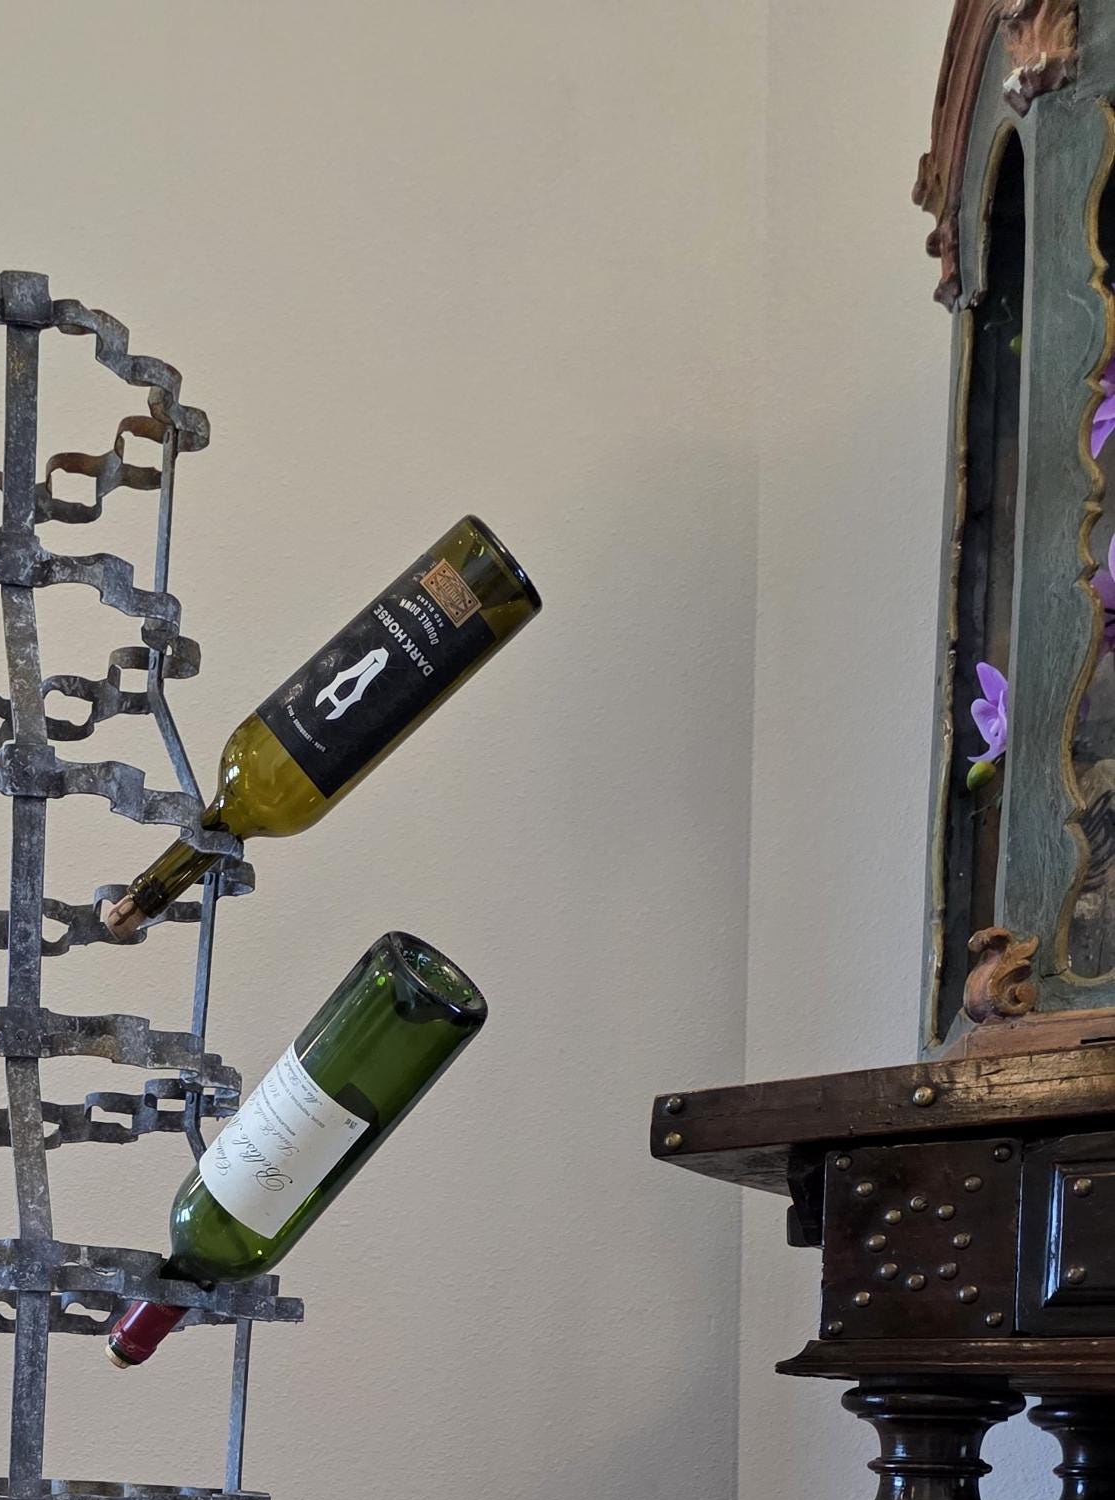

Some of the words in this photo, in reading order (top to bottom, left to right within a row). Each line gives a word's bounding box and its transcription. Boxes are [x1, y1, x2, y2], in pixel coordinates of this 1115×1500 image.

[399, 598, 424, 616] DOWN
[416, 594, 436, 613] BLEND
[373, 604, 408, 644] HORSE
[417, 612, 440, 645] DOUBLE
[433, 613, 444, 628] RED
[402, 638, 434, 677] DARK
